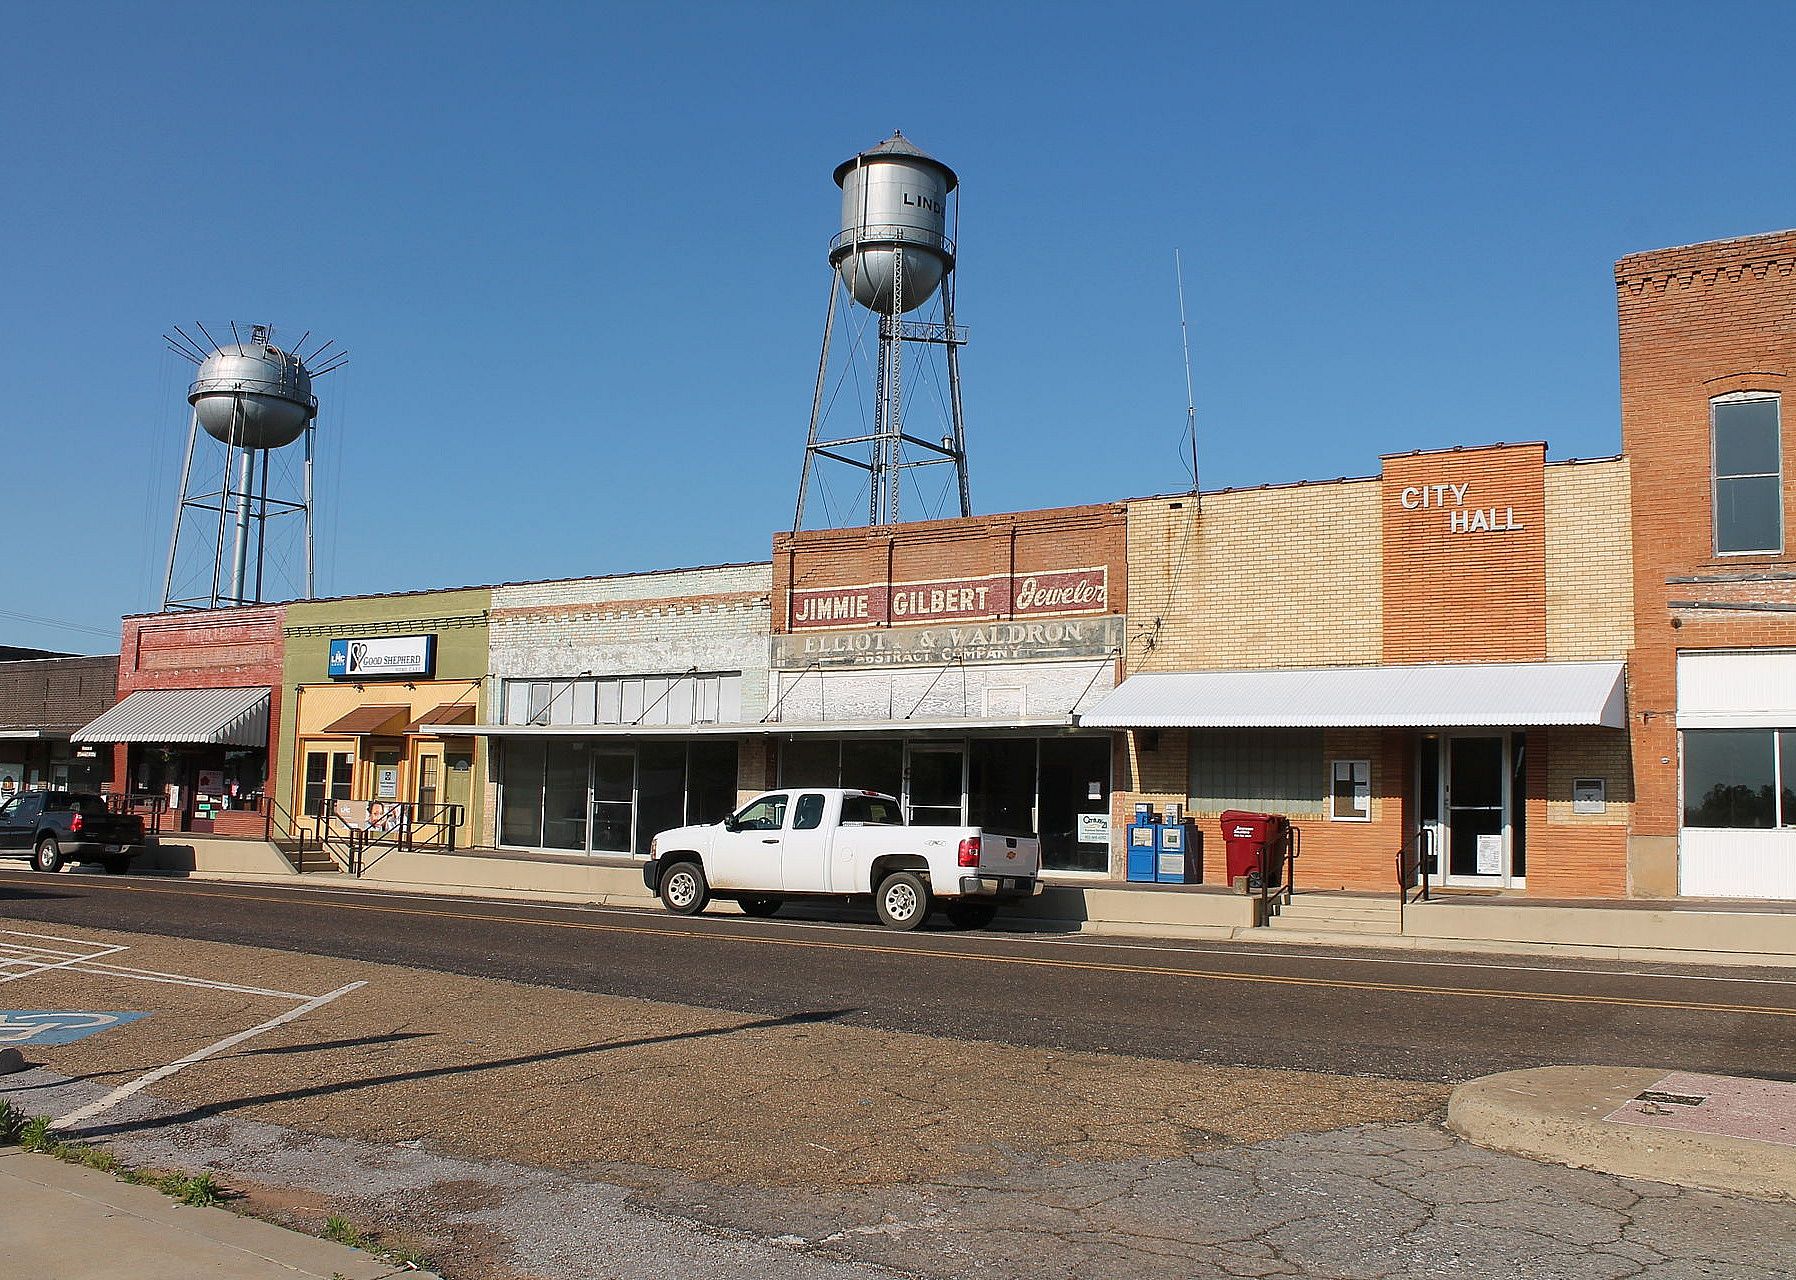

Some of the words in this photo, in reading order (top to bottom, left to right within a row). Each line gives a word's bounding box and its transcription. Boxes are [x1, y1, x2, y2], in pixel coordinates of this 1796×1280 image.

[1401, 483, 1469, 509] CITY
[1450, 507, 1524, 533] HALL
[795, 595, 869, 621] JIMMIE
[893, 587, 989, 616] GILBERT
[920, 631, 936, 648] &
[363, 656, 382, 666] GOOD
[383, 655, 421, 665] SHEPHERD
[854, 650, 930, 665] ABSTRACT
[941, 645, 1021, 661] COMPANY
